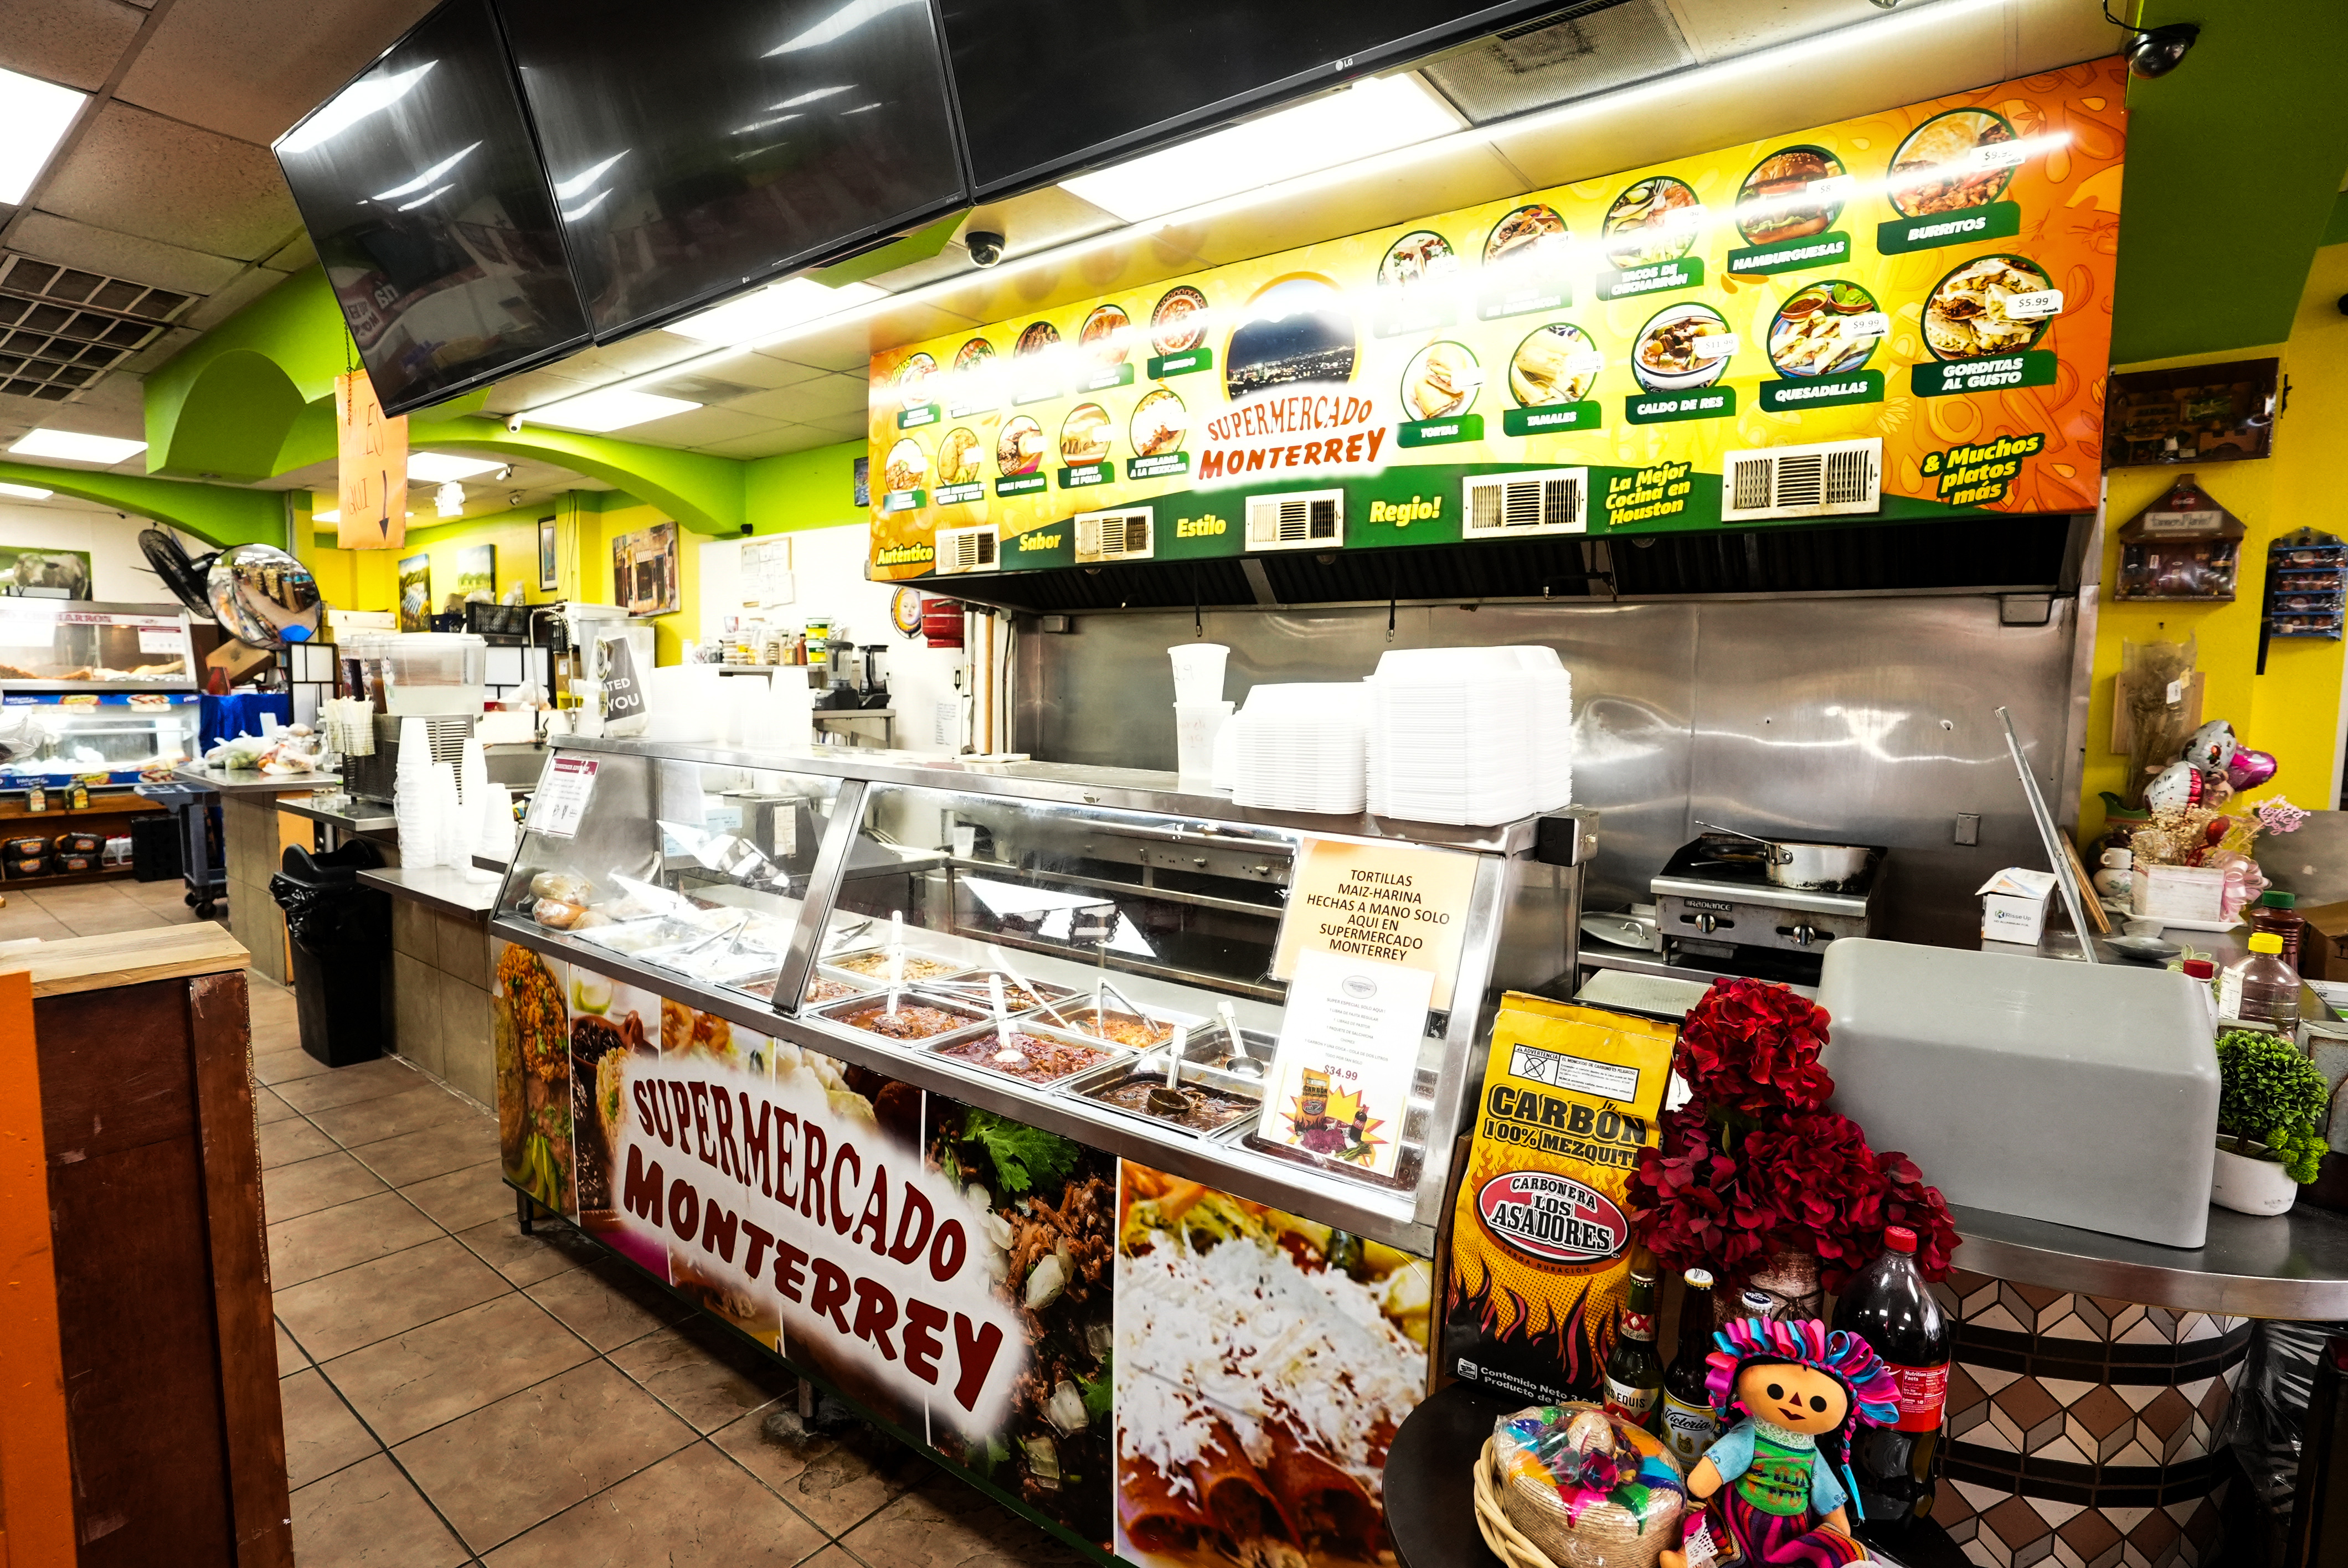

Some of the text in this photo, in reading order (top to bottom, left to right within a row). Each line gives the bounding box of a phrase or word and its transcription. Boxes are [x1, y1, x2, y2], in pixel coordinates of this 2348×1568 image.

[1908, 216, 1986, 241] BURRITOS
[1732, 241, 1845, 271] HAMBURGUESAS
[1621, 264, 1678, 282] TACOS DE
[2018, 297, 2049, 308] $5.99
[1853, 319, 1880, 329] $9.99
[1943, 358, 2024, 378] GORDITAS
[1775, 381, 1868, 403] QUESADILLAS
[1942, 372, 2022, 391] AL GUSTO
[1637, 396, 1724, 415] CALDO DE RES
[1208, 395, 1373, 441] SUPERMERCADO
[1527, 411, 1577, 426] TAMALES
[1420, 425, 1459, 438] TORTAS
[1198, 427, 1386, 480] MONTERREY
[1924, 436, 2040, 473] & Muchos
[1609, 463, 1688, 493] La Mejor
[1940, 461, 2016, 494] platos
[1606, 481, 1691, 509] Cocina en
[1952, 480, 2002, 506] más
[1369, 496, 1441, 528] Regio!
[1609, 499, 1683, 525] Houston
[1177, 514, 1227, 538] Estilo
[1019, 531, 1060, 551] Sabor
[876, 542, 934, 565] Auténtico
[609, 693, 640, 711] YOU
[1351, 869, 1413, 886] TORTILLAS
[1338, 883, 1422, 904] MAIZ-HARINA
[1307, 894, 1450, 925] HECHAS A MANO SOLO
[1347, 914, 1399, 931] AQUI EN
[1319, 923, 1423, 950] SUPERMERCADO
[1329, 938, 1408, 961] MONTERREY
[1340, 1000, 1360, 1009] ESPECIAL
[1351, 1031, 1374, 1040] SALCHICHA
[1523, 1048, 1558, 1060] ADVERTENCIA
[1324, 1064, 1358, 1081] $34.99
[1490, 1085, 1649, 1146] CARBÓN
[1484, 1119, 1538, 1148] 100%
[632, 1077, 966, 1283] SUPERMERCADO
[1511, 1177, 1597, 1211] CARBONERA
[1533, 1195, 1573, 1217] LOS
[1492, 1203, 1612, 1250] ASADORES
[1502, 1245, 1590, 1274] LARGA DURACIÓN
[622, 1143, 1005, 1414] MONTERREY
[1480, 1366, 1537, 1390] Contenido
[1539, 1384, 1568, 1400] Neto
[1484, 1376, 1535, 1399] Producto
[1537, 1394, 1552, 1406] de
[1616, 1392, 1645, 1409] EQUIS
[1665, 1407, 1711, 1431] Victoria
